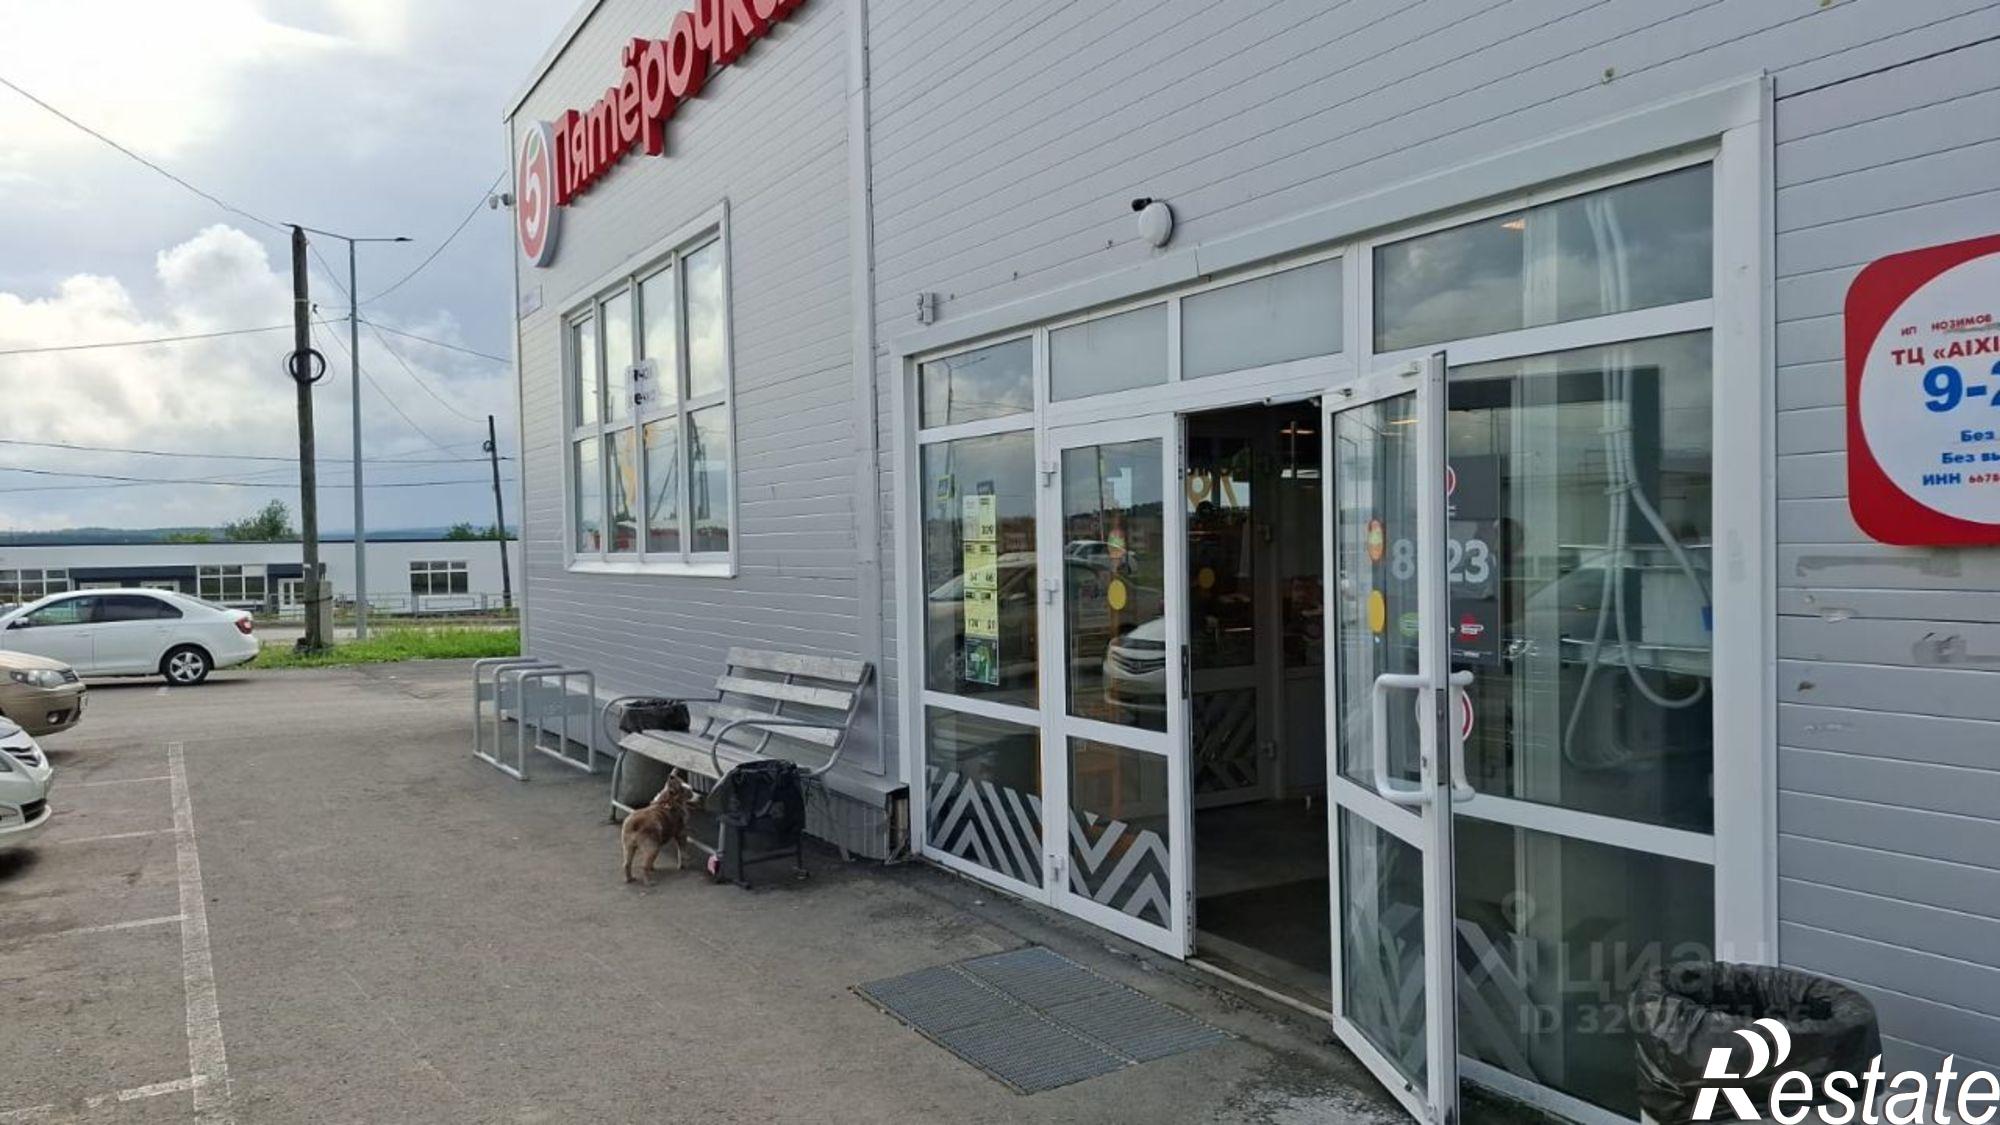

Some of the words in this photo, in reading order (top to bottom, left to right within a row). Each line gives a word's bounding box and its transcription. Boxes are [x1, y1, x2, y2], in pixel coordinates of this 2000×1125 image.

[1901, 325, 1917, 336] ИП
[1891, 346, 1925, 366] ТЦ
[1923, 361, 2000, 413] 9-
[1960, 430, 1995, 443] Без
[1941, 452, 1975, 464] Без
[1923, 472, 1961, 486] ИНН
